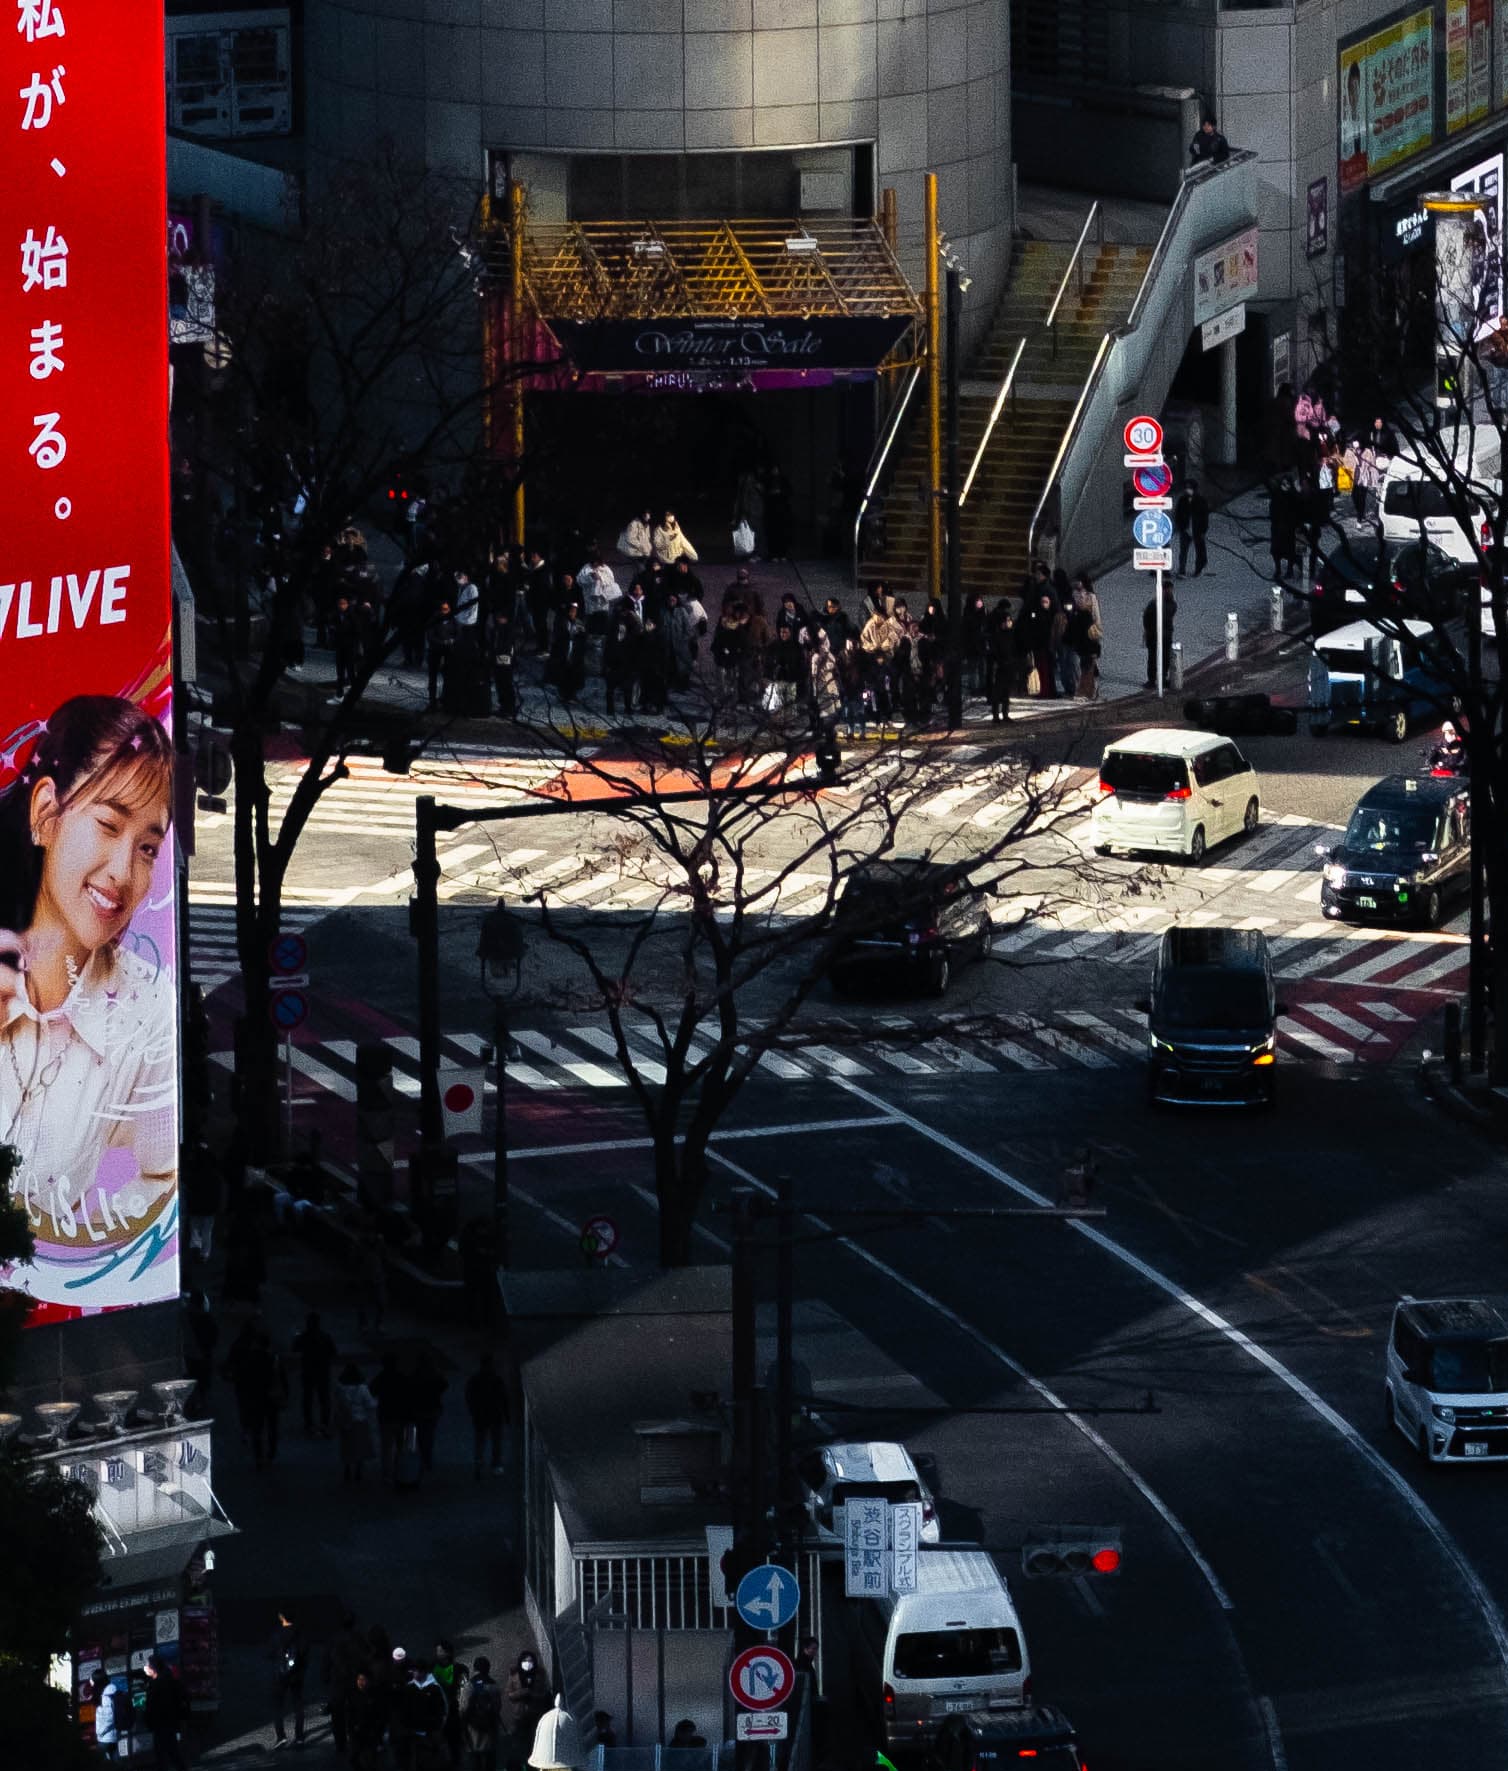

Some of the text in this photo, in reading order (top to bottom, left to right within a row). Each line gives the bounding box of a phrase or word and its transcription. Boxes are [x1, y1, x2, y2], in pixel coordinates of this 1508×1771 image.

[17, 0, 71, 520] 私が、始まる。
[635, 330, 822, 354] Winter Sale
[1133, 428, 1154, 444] 30
[863, 1505, 882, 1589] 渋谷駅前
[898, 1508, 913, 1590] スクランブル式
